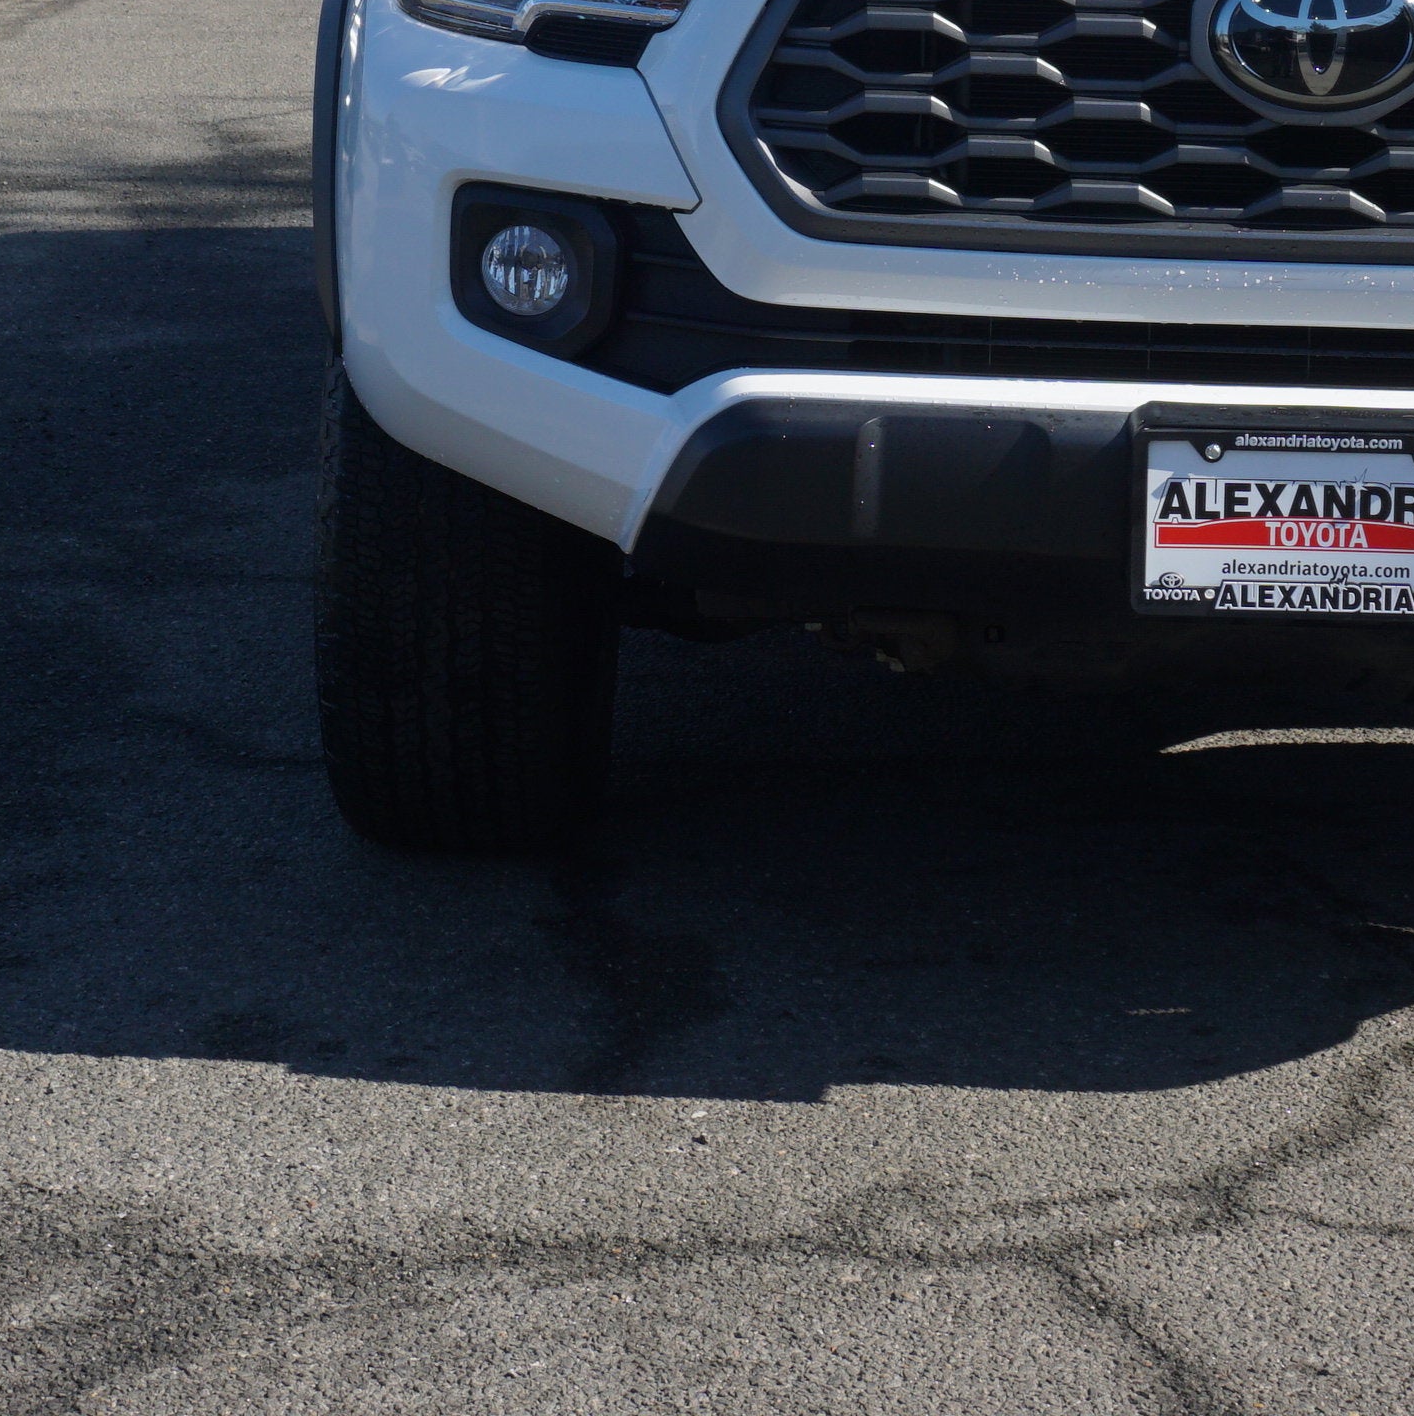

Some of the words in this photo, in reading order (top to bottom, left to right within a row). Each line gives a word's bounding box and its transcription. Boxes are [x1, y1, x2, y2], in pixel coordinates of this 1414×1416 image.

[1234, 434, 1403, 451] alexandriatoyota.com
[1265, 521, 1369, 548] TOYOTA
[1221, 559, 1411, 580] alexandriatoyota.com
[1143, 588, 1201, 601] TOYOTA
